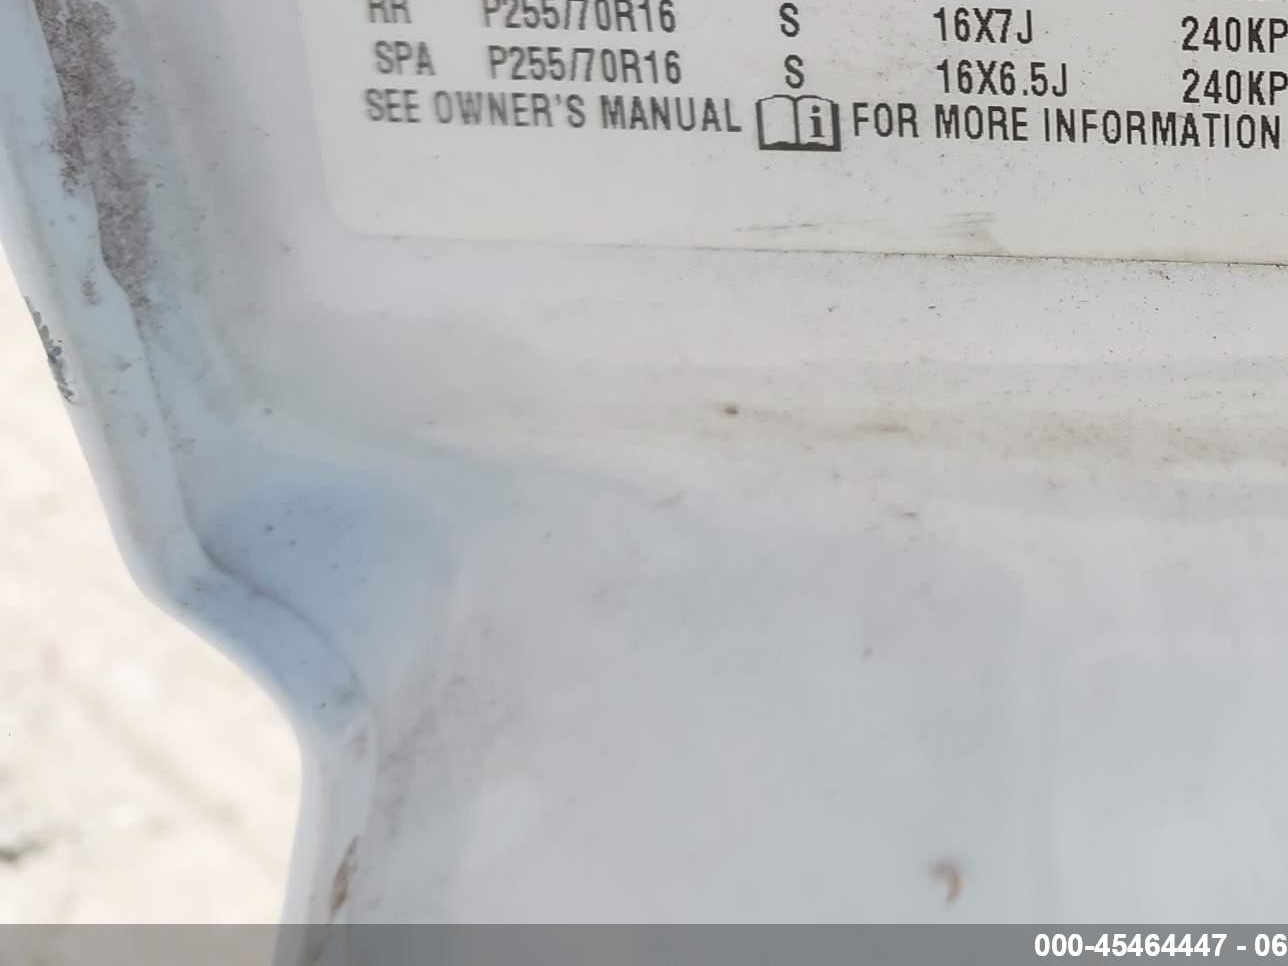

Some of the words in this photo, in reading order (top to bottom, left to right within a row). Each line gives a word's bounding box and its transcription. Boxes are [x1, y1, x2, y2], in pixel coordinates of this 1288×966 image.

[779, 3, 800, 37] S
[933, 7, 1032, 44] 16X7J
[376, 41, 434, 75] SPA
[488, 45, 681, 84] P255/70R16
[784, 55, 804, 89] S
[936, 59, 1067, 97] 16X6.5J
[366, 89, 419, 123] SEE
[435, 91, 585, 128] OWNER'S
[600, 95, 742, 132] MANUAL
[853, 103, 919, 138] FOR
[935, 104, 1028, 141] MORE
